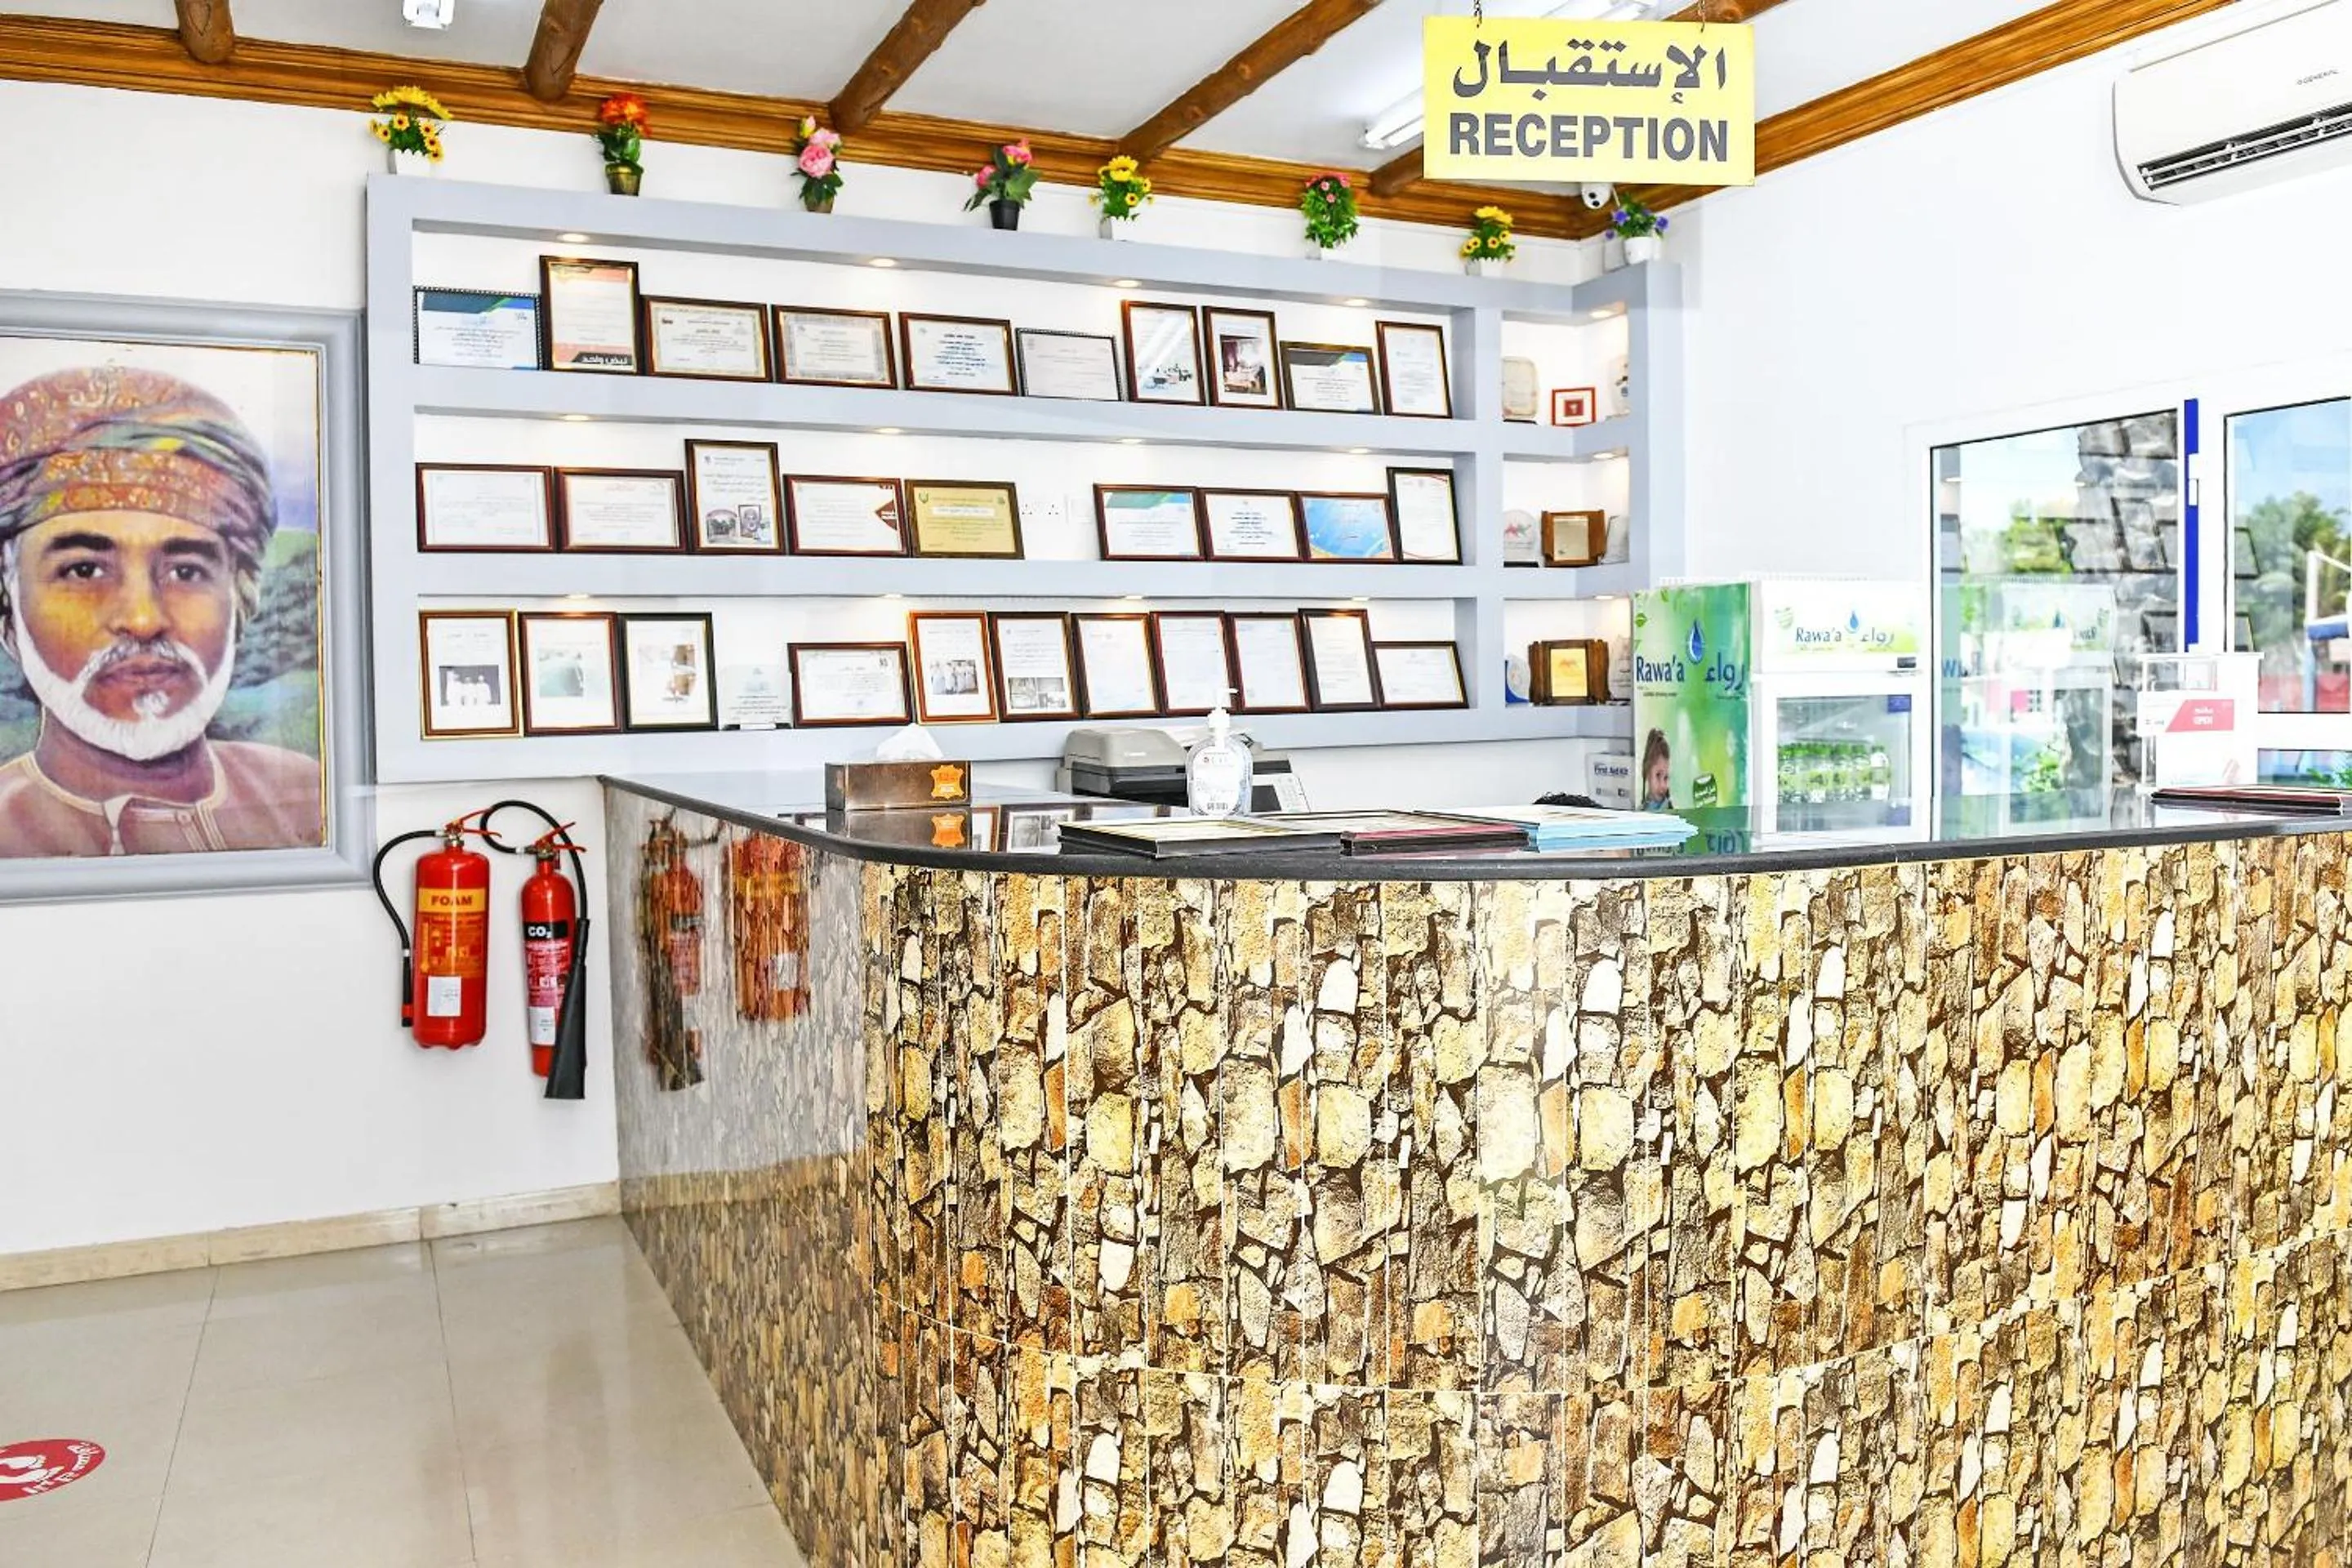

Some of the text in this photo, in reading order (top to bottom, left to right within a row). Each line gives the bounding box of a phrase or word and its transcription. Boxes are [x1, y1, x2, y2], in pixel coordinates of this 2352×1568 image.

[1452, 38, 1726, 105] الإستقبال
[1449, 112, 1729, 163] RECEPTION
[1796, 626, 1842, 643] Rawa'a
[1635, 654, 1685, 683] Rawa'a
[430, 895, 473, 906] FOAM
